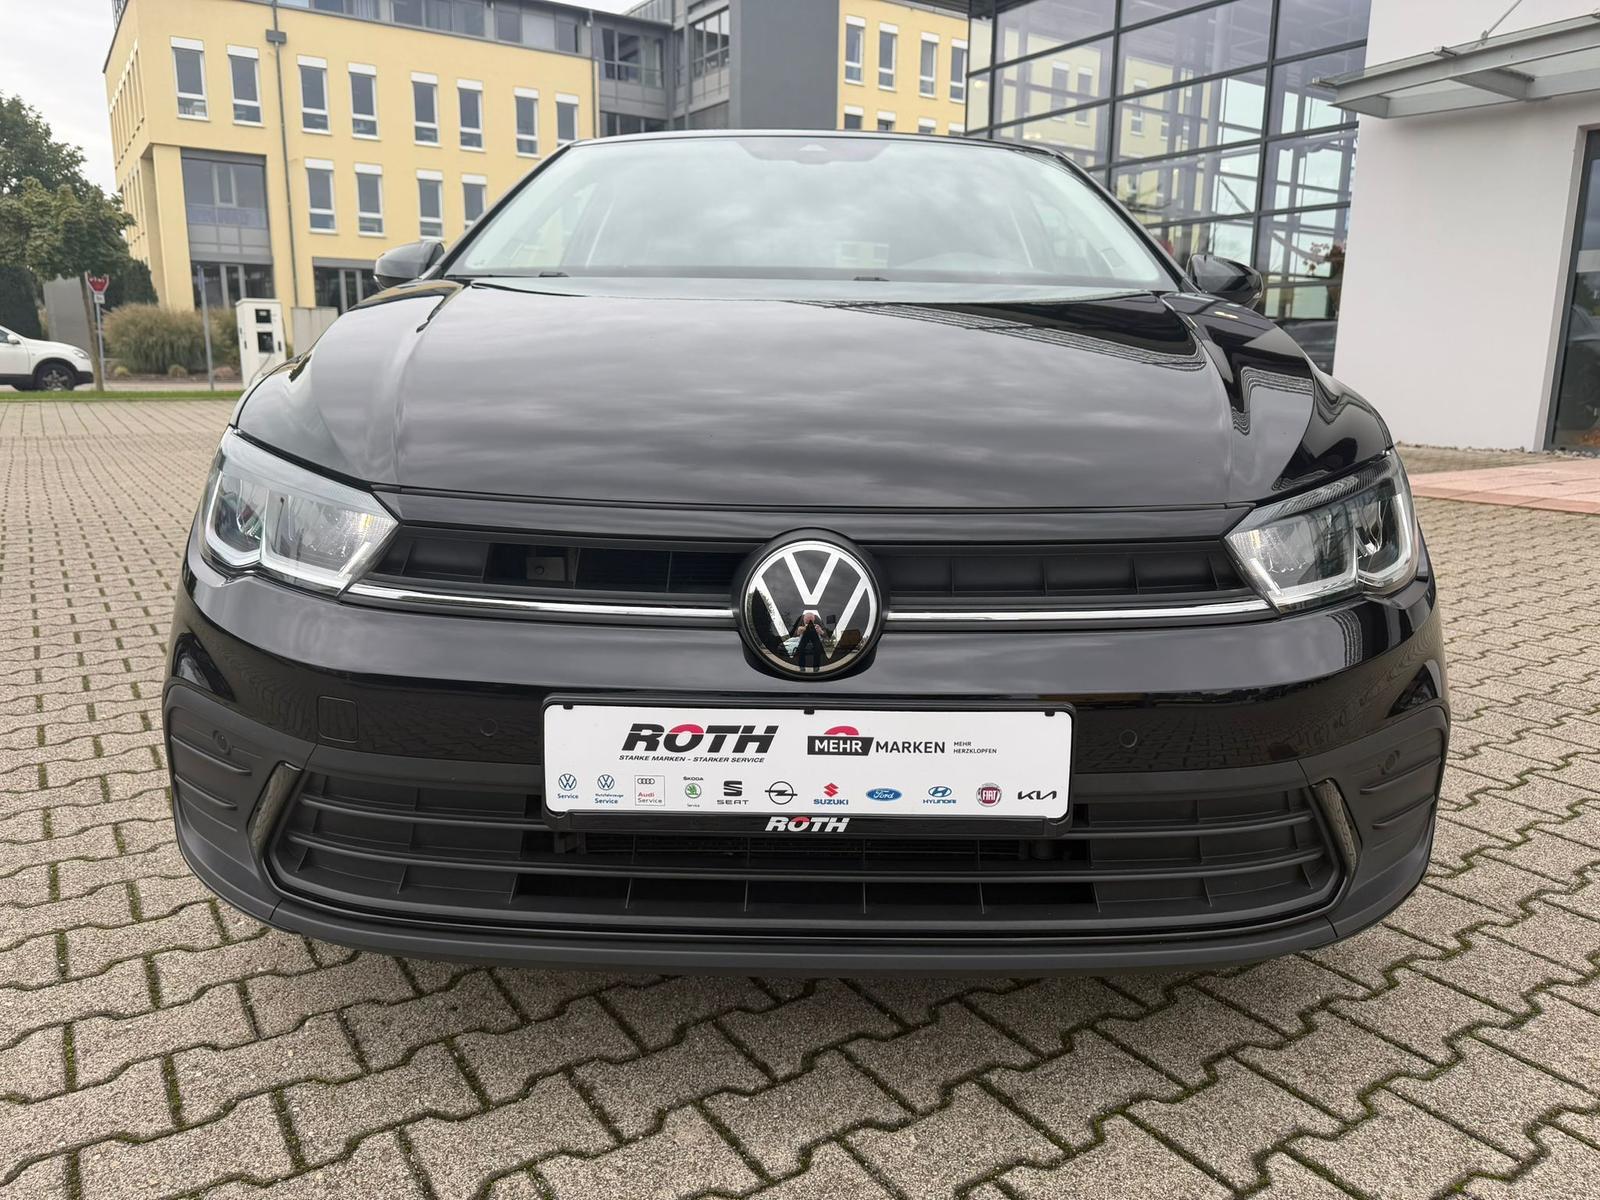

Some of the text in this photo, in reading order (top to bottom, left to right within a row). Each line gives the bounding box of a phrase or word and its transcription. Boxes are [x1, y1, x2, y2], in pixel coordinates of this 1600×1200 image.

[621, 723, 779, 753] ROTH
[814, 739, 946, 754] MEHR MARKEN
[873, 790, 895, 799] Ford
[982, 790, 998, 800] FIAT
[764, 816, 851, 833] ROTH
